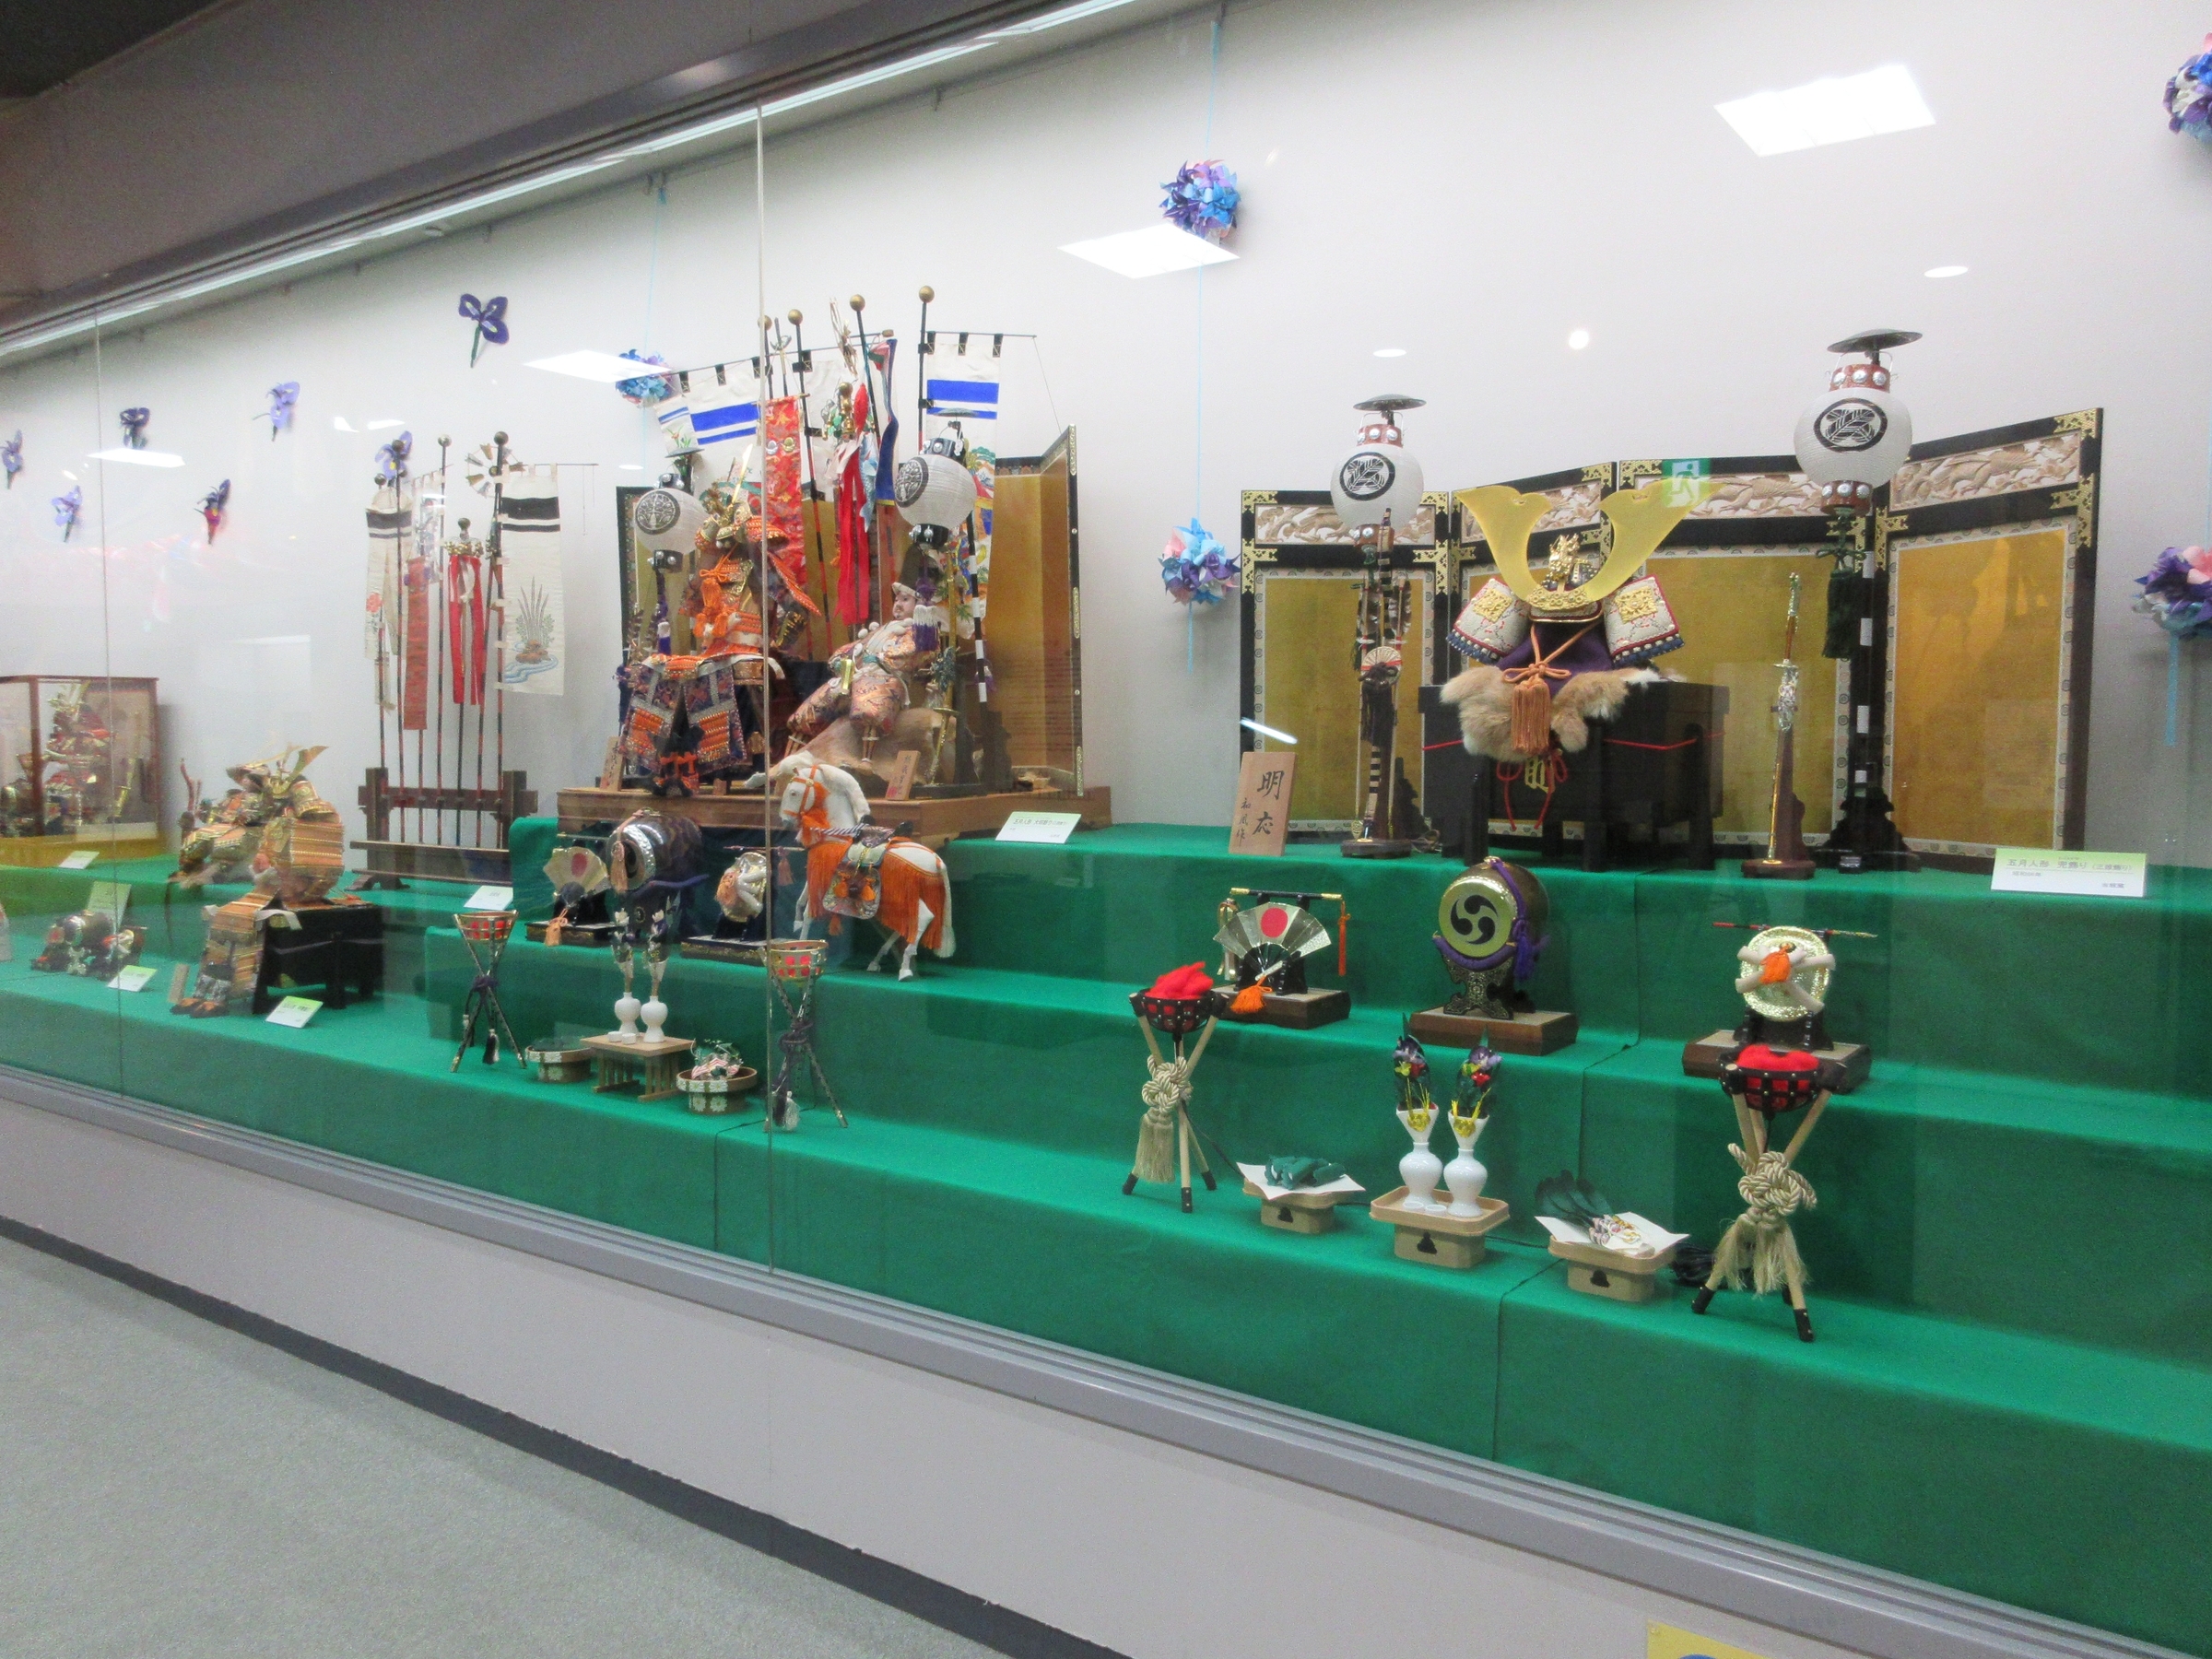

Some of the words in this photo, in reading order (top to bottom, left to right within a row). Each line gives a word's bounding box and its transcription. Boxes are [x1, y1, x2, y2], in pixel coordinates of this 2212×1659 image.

[1252, 770, 1285, 835] 明応
[2006, 858, 2049, 867] 五月人形
